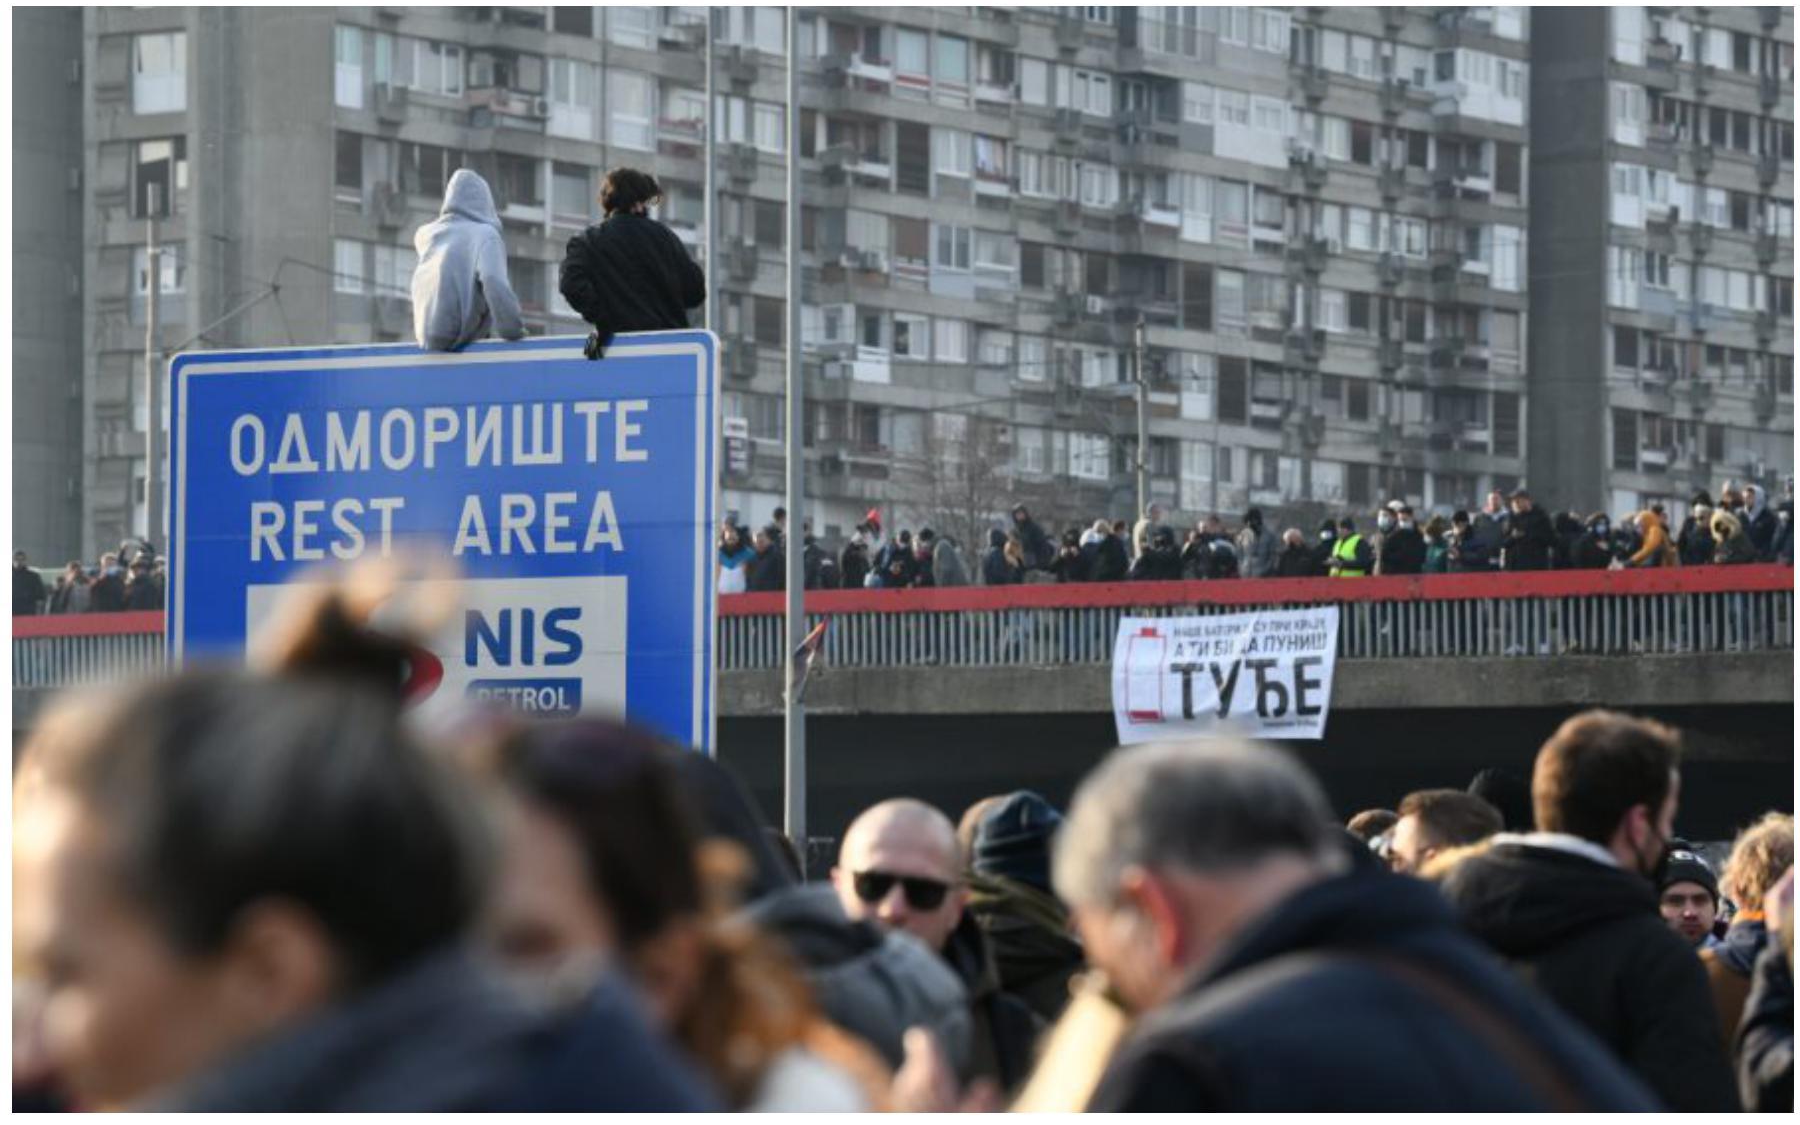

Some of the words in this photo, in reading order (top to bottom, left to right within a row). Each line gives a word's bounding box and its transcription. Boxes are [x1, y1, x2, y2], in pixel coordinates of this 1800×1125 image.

[229, 399, 649, 475] ОДМОРИШТЕ
[250, 497, 405, 562] REST
[453, 490, 625, 556] AREA
[465, 607, 583, 667] NIS
[1263, 632, 1328, 652] ПУНИШ
[1170, 656, 1323, 720] ТУЂЕ
